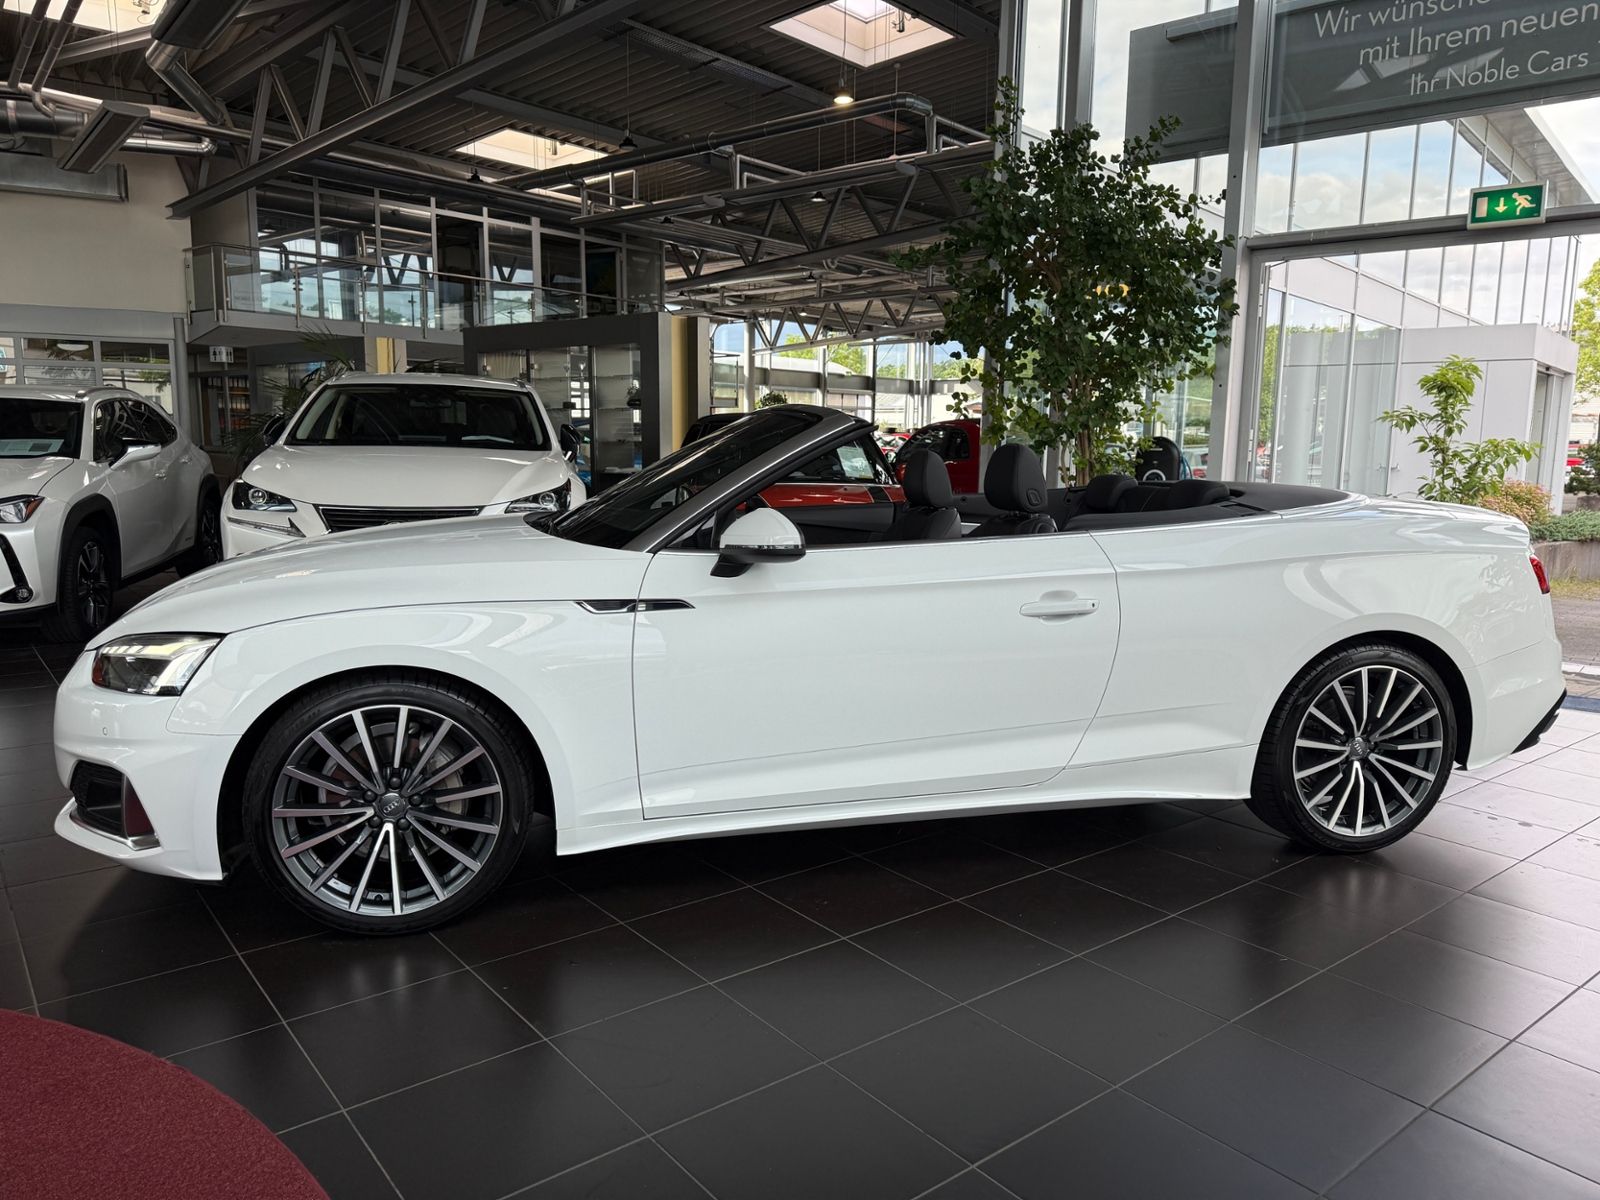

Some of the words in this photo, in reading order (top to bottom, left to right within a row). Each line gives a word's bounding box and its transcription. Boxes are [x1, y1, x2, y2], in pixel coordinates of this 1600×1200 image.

[1315, 6, 1362, 38] Wir
[1368, 0, 1491, 26] wünsc
[1359, 35, 1401, 65] mit
[1408, 26, 1491, 56] Ihrem
[1500, 2, 1599, 38] neuen
[1410, 72, 1440, 96] Ihr
[1446, 57, 1520, 90] Noble
[1527, 50, 1589, 75] Cars
